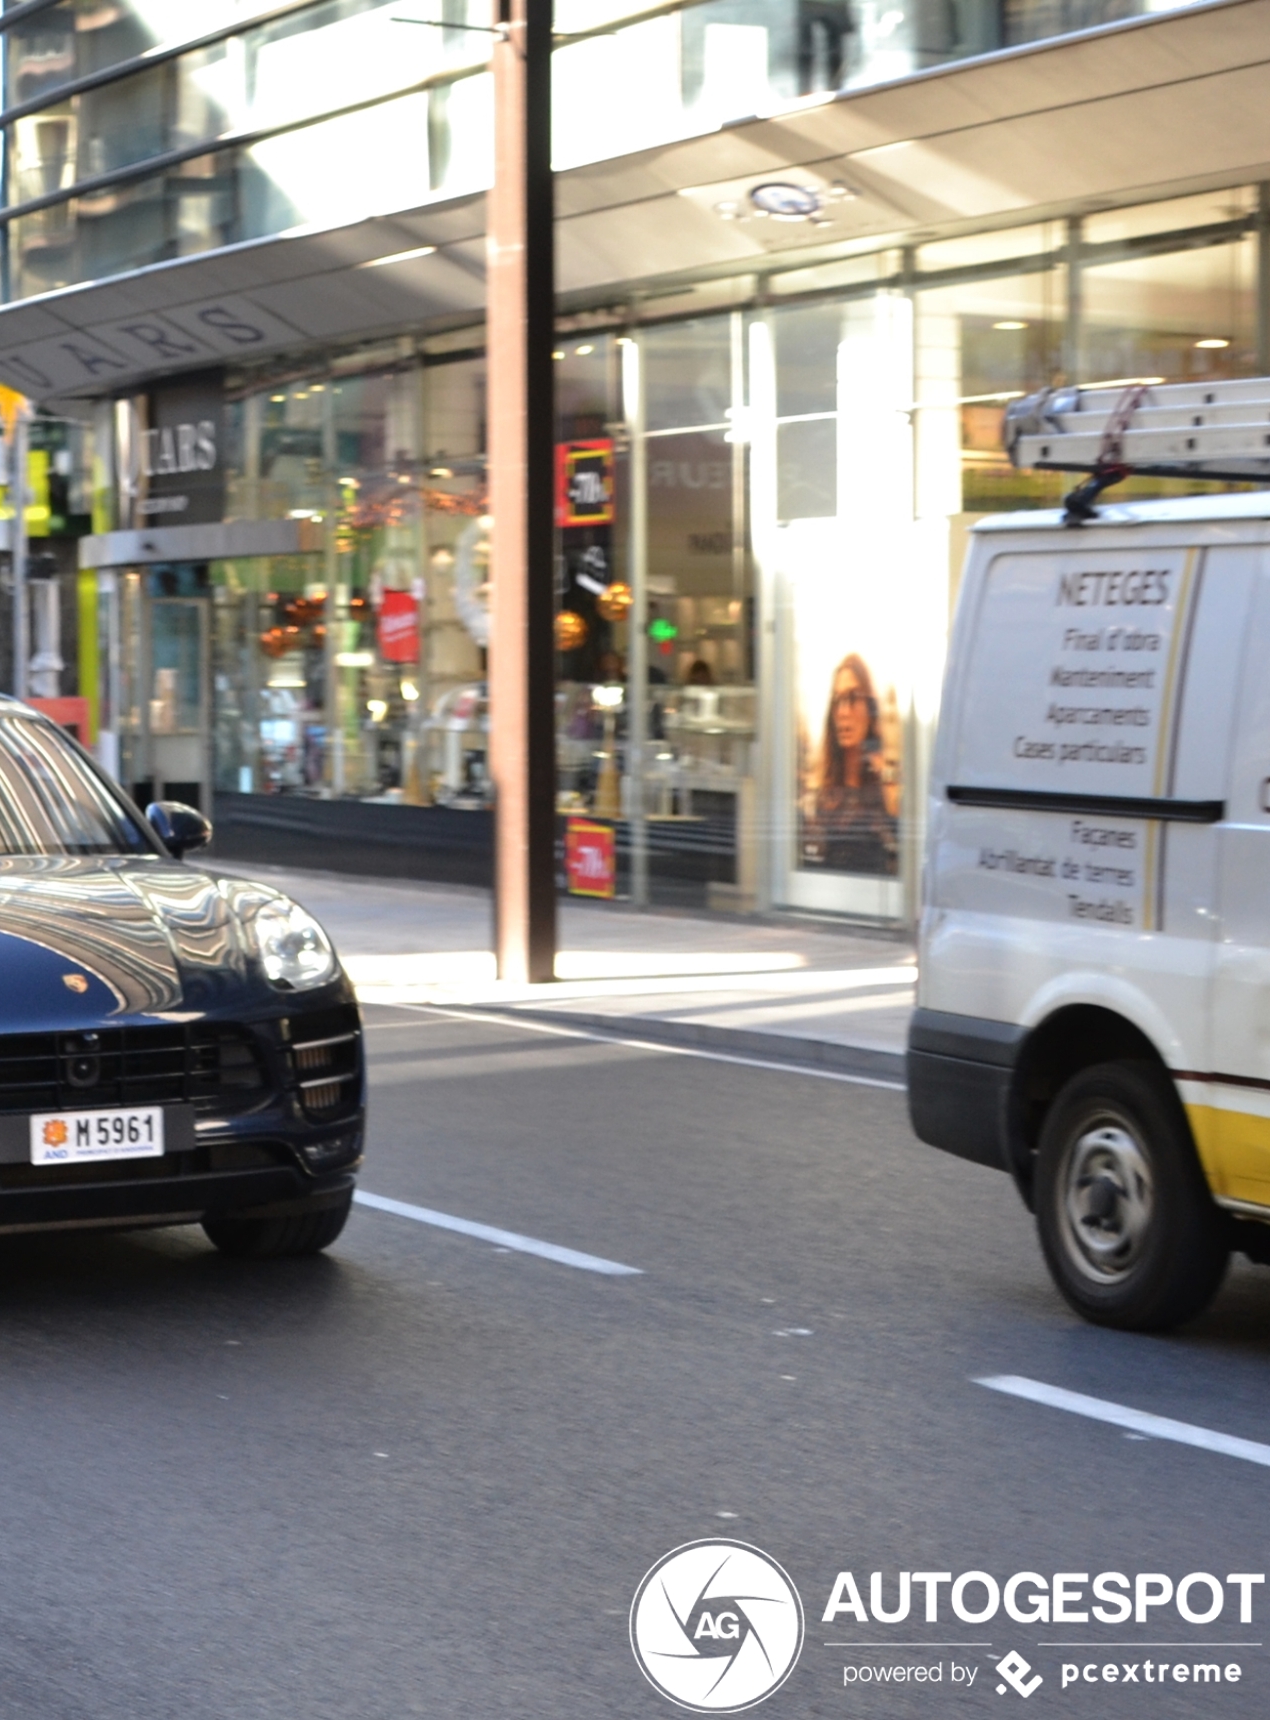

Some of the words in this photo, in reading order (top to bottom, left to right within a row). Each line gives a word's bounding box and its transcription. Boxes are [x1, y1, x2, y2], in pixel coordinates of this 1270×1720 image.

[1056, 570, 1171, 606] NETEGES
[1064, 628, 1104, 651] Final
[1050, 666, 1155, 689] Manteniment
[1046, 703, 1150, 728] Aparcaments
[1014, 735, 1055, 760] Cases
[1059, 740, 1146, 766] particulars
[1071, 820, 1136, 851] Façanes
[1061, 856, 1080, 880] de
[76, 1118, 90, 1147] M
[97, 1114, 153, 1145] 5961
[44, 1149, 68, 1160] AND
